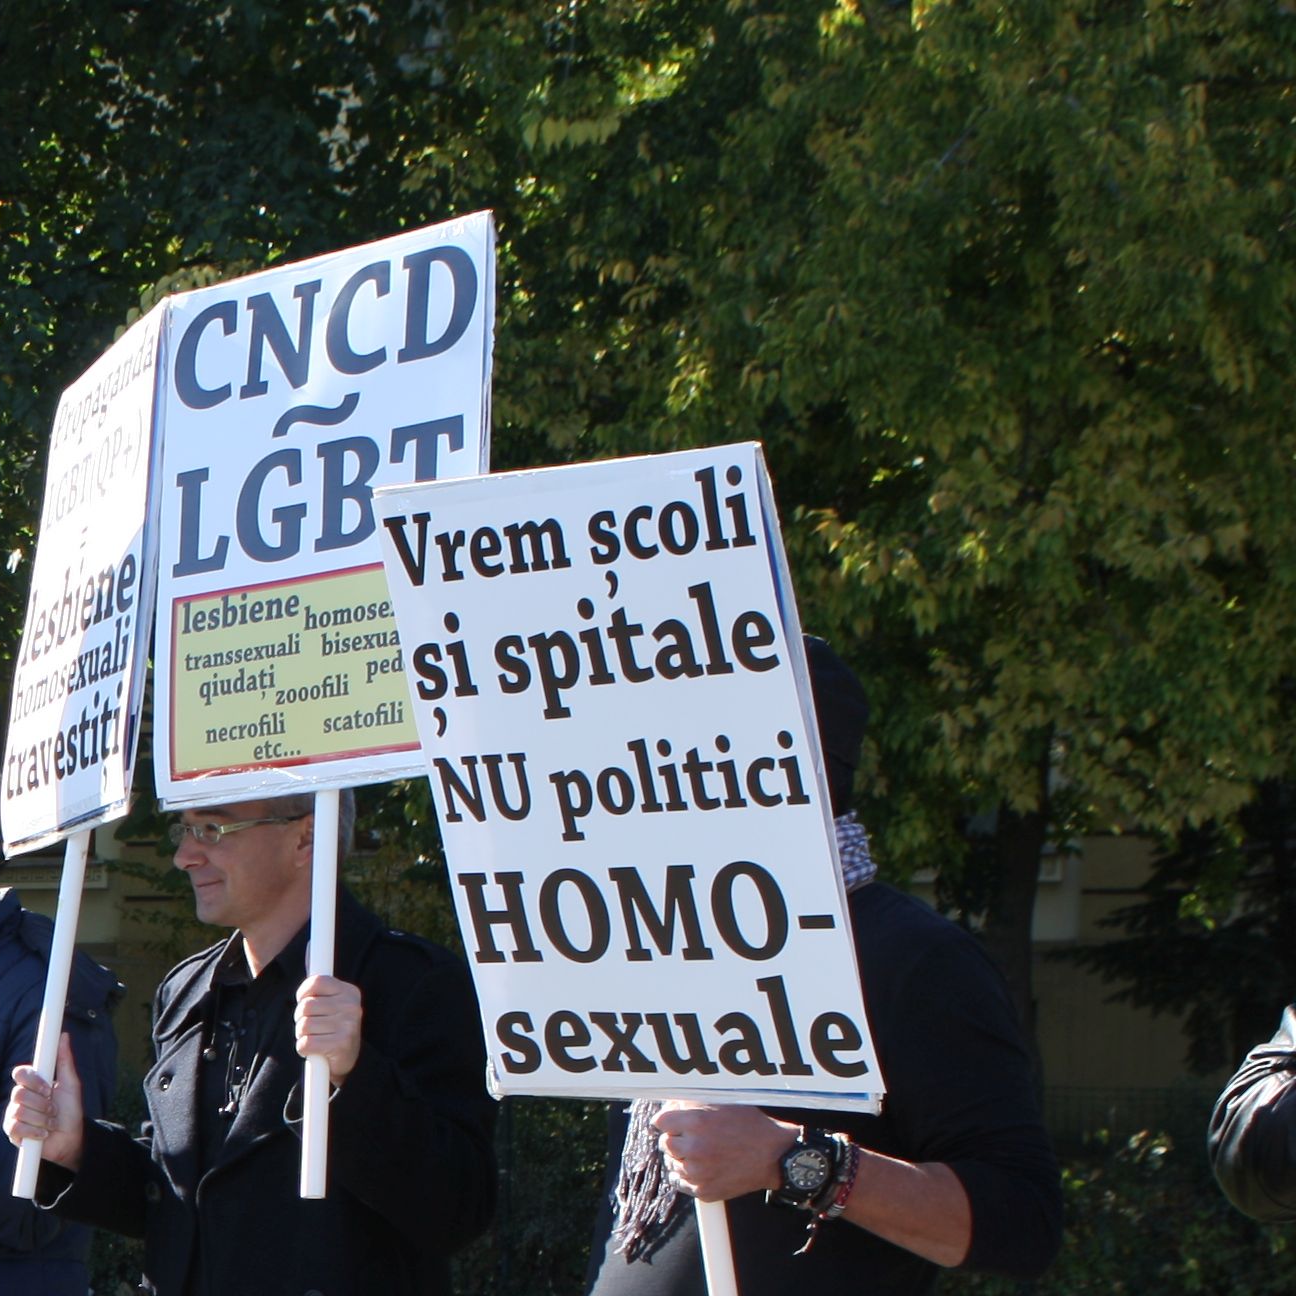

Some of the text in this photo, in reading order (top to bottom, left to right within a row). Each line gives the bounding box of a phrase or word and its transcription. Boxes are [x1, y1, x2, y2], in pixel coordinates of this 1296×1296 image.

[174, 245, 479, 411] CNCD
[53, 322, 155, 446] Propaganda
[171, 414, 465, 579] LGBT
[383, 464, 757, 600] Vrem școli
[19, 550, 137, 669] lesbiene
[181, 592, 301, 635] lesbiene
[184, 629, 401, 672] transsexuali bisexua
[412, 581, 781, 738] și spitale
[12, 613, 132, 724] homosexuali
[275, 673, 350, 705] zooofili
[365, 648, 405, 684] ped
[205, 701, 405, 744] necrofili scatofili
[252, 739, 302, 760] etc...
[432, 730, 810, 842] NU politici
[457, 859, 836, 965] HOMO-
[494, 974, 870, 1080] sexuale
